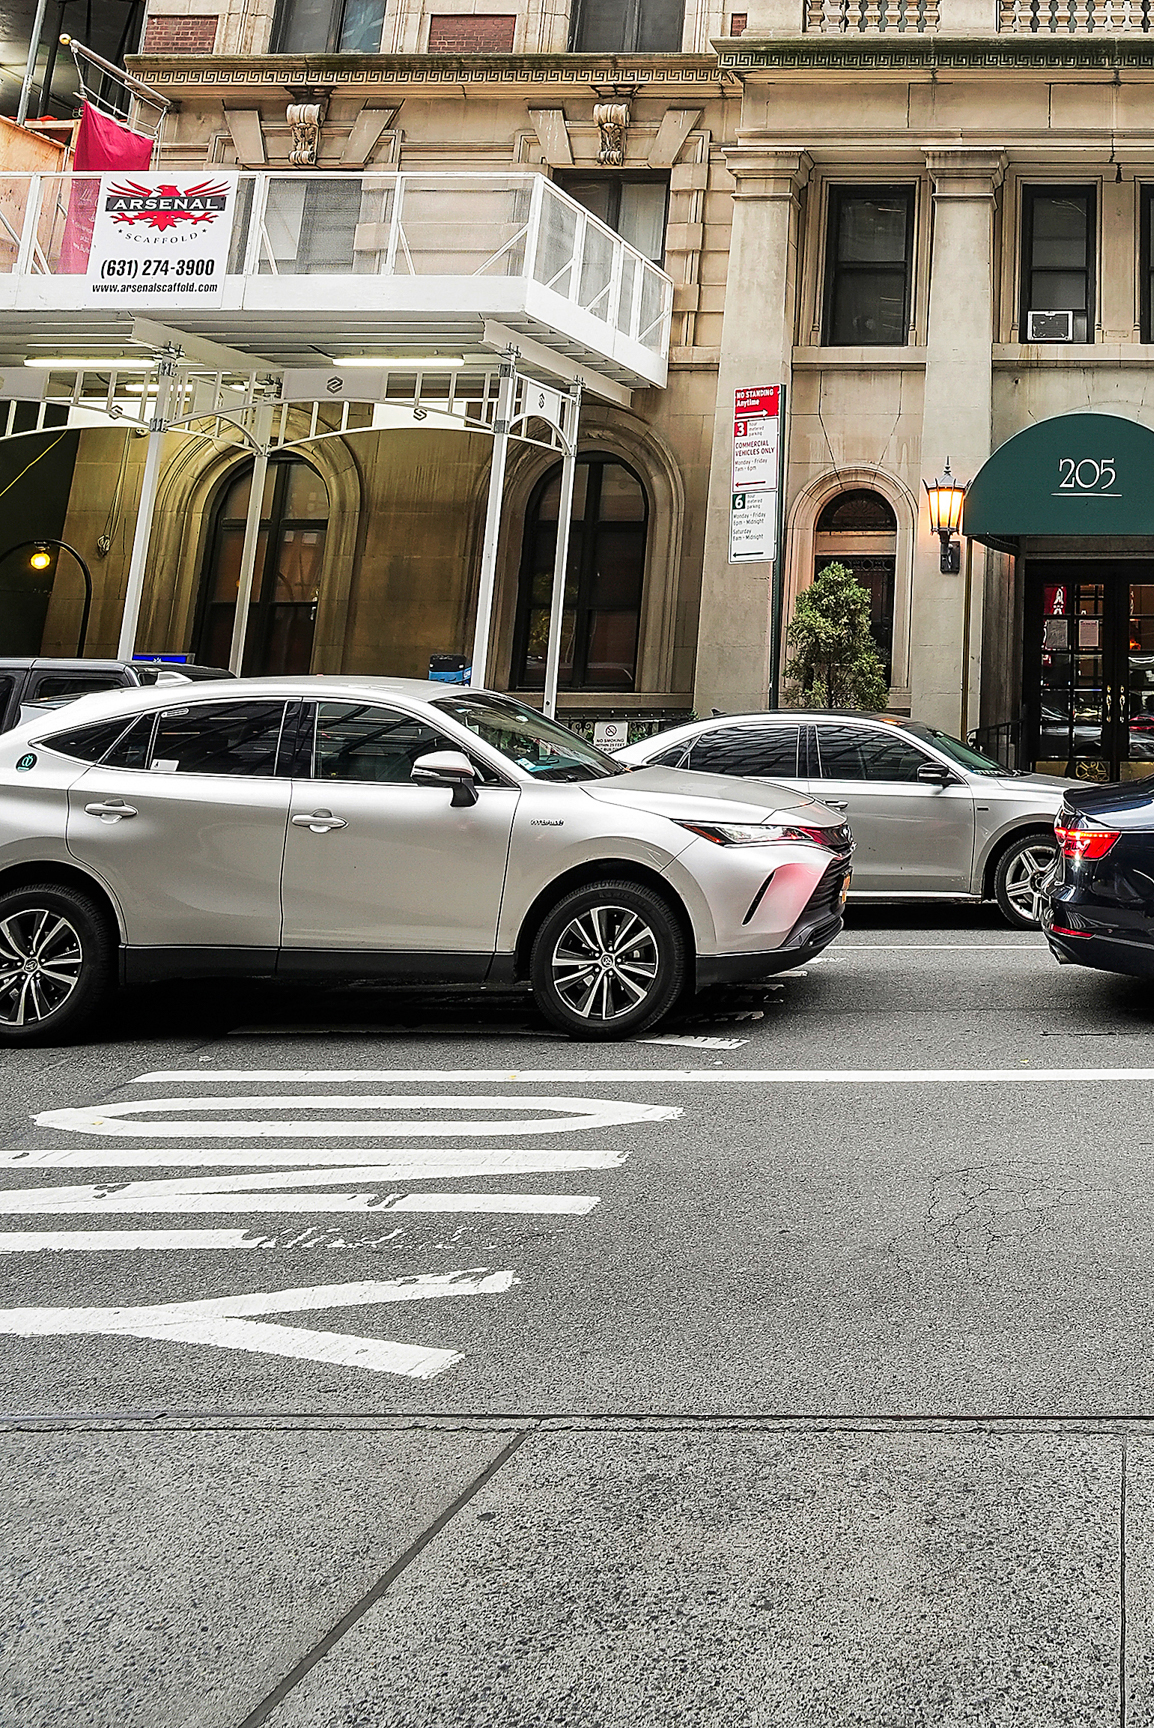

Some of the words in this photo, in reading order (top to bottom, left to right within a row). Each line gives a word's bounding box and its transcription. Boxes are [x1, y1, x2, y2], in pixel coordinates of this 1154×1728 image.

[112, 199, 219, 210] ARSENAL
[125, 232, 198, 244] SCAFFOLD
[101, 259, 138, 279] (631)
[142, 259, 215, 276] 274-3900
[92, 282, 218, 293] www.arsenalscaffold.com
[736, 391, 744, 399] NO
[746, 388, 774, 397] STANDING
[736, 399, 760, 408] Anytime
[736, 422, 745, 436] 3
[736, 440, 769, 449] COMMERCIAL
[736, 448, 760, 456] VEHICLES
[1058, 458, 1116, 490] 205
[735, 495, 743, 509] 6
